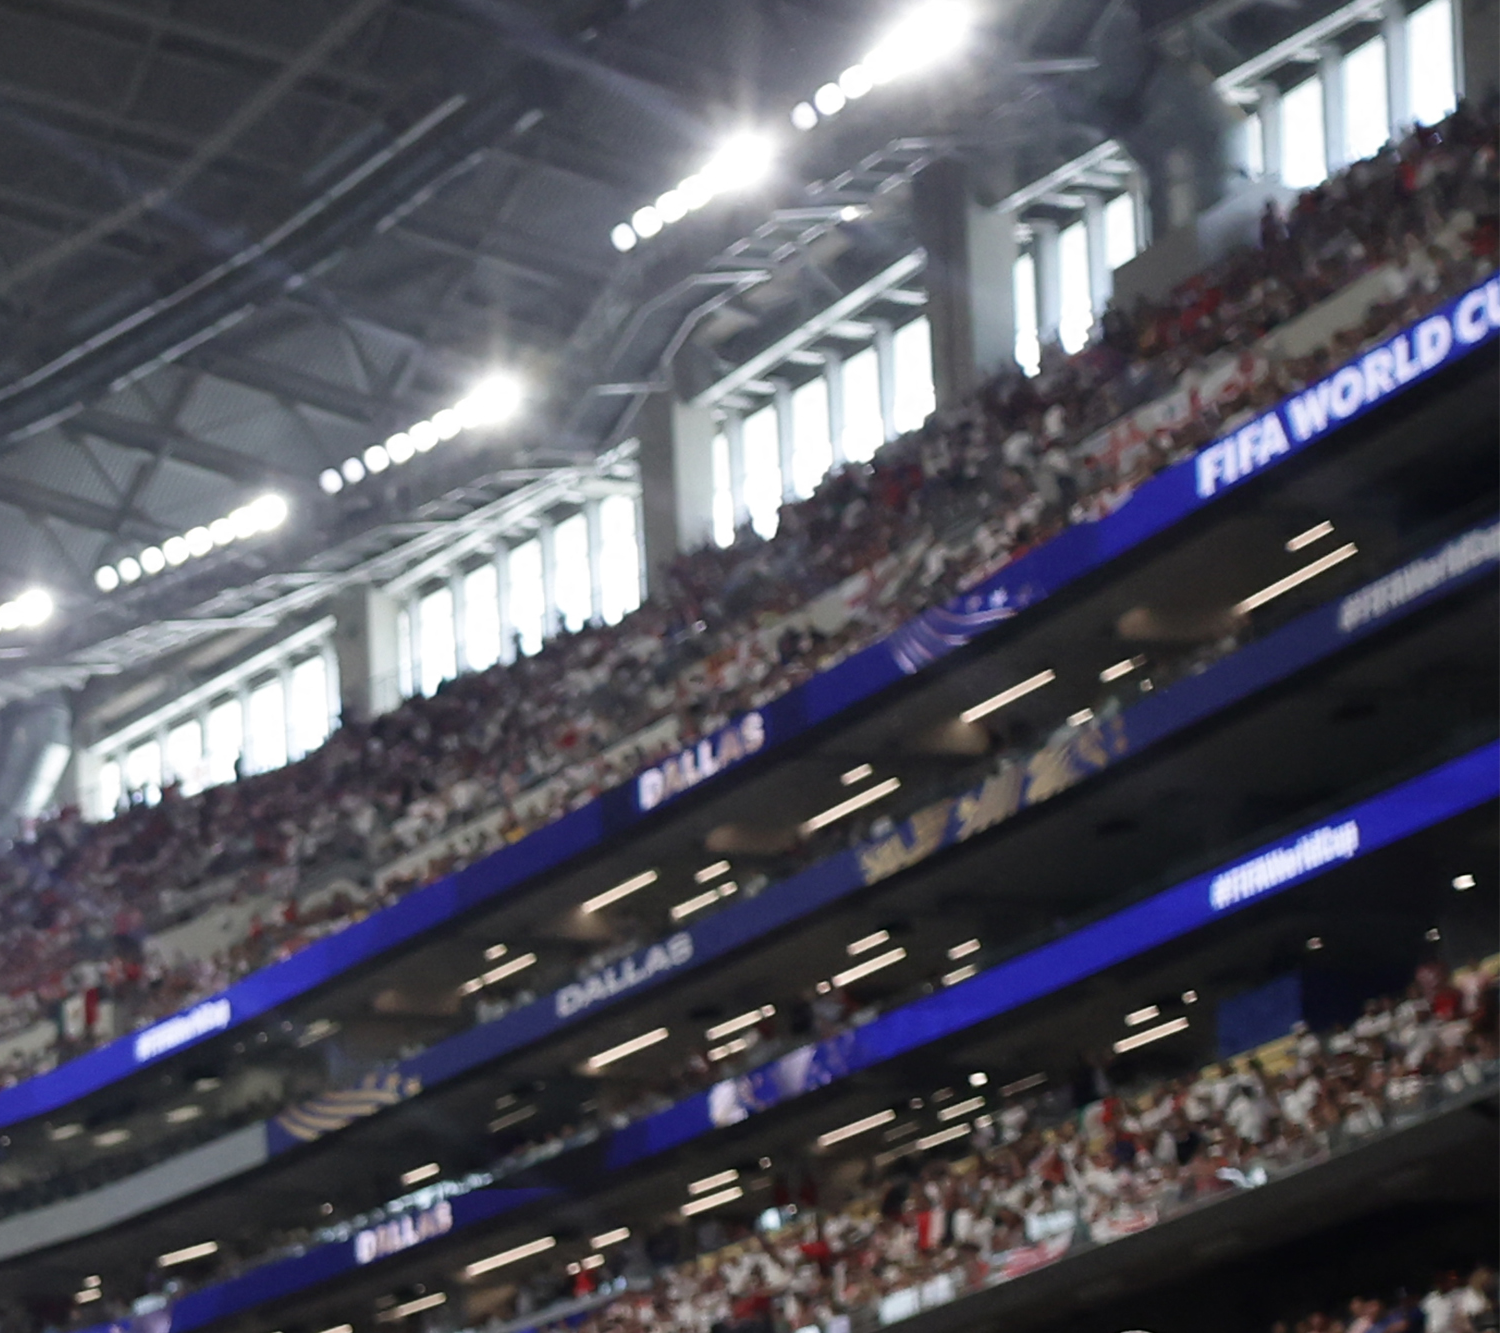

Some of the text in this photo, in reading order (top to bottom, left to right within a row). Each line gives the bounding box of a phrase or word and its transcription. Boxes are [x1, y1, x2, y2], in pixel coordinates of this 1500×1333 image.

[1195, 411, 1291, 498] FIFA
[1287, 315, 1451, 442] WORLD
[638, 712, 765, 812] DALLAS
[555, 931, 694, 1018] DALLAS
